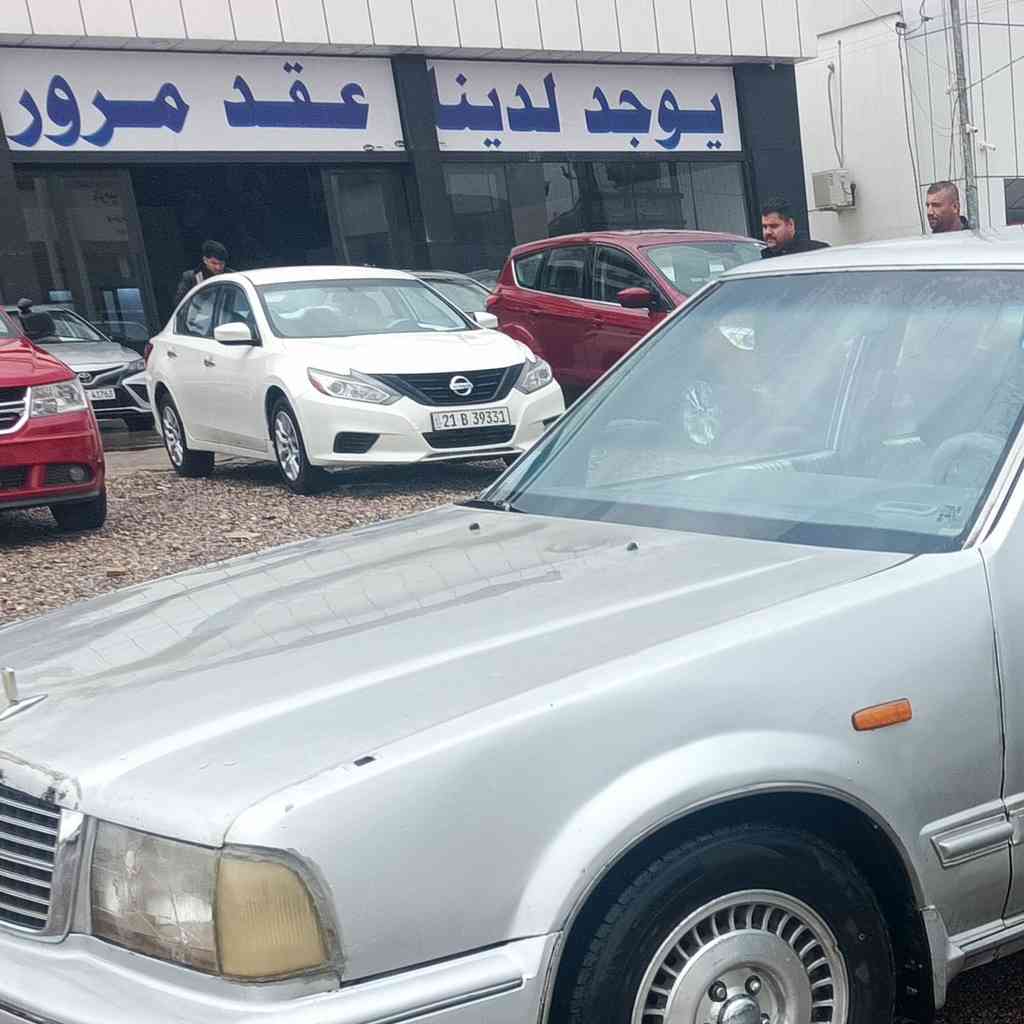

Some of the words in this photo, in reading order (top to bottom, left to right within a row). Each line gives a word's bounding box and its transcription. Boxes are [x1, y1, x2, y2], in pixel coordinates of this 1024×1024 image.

[4, 74, 190, 146] مرور
[223, 62, 370, 130] عقد
[433, 72, 561, 148] لدين
[585, 86, 724, 149] يوجد
[442, 414, 457, 427] 21
[461, 413, 469, 425] B
[471, 410, 506, 425] 39331
